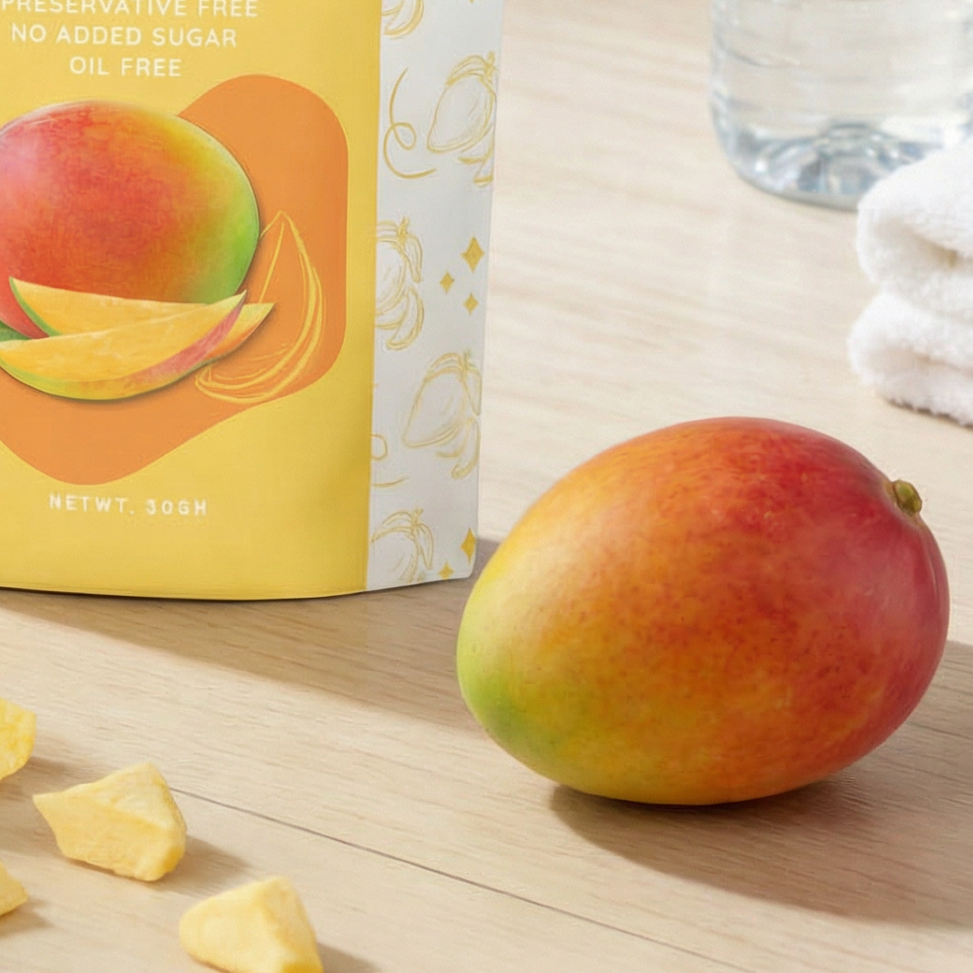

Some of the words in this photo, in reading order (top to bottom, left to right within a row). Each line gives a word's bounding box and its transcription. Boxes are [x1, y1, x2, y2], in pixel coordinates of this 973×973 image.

[10, 23, 47, 43] NO
[55, 25, 142, 46] ADDED
[151, 27, 237, 48] SUGAR
[69, 56, 107, 76] OIL
[120, 58, 182, 78] FREE
